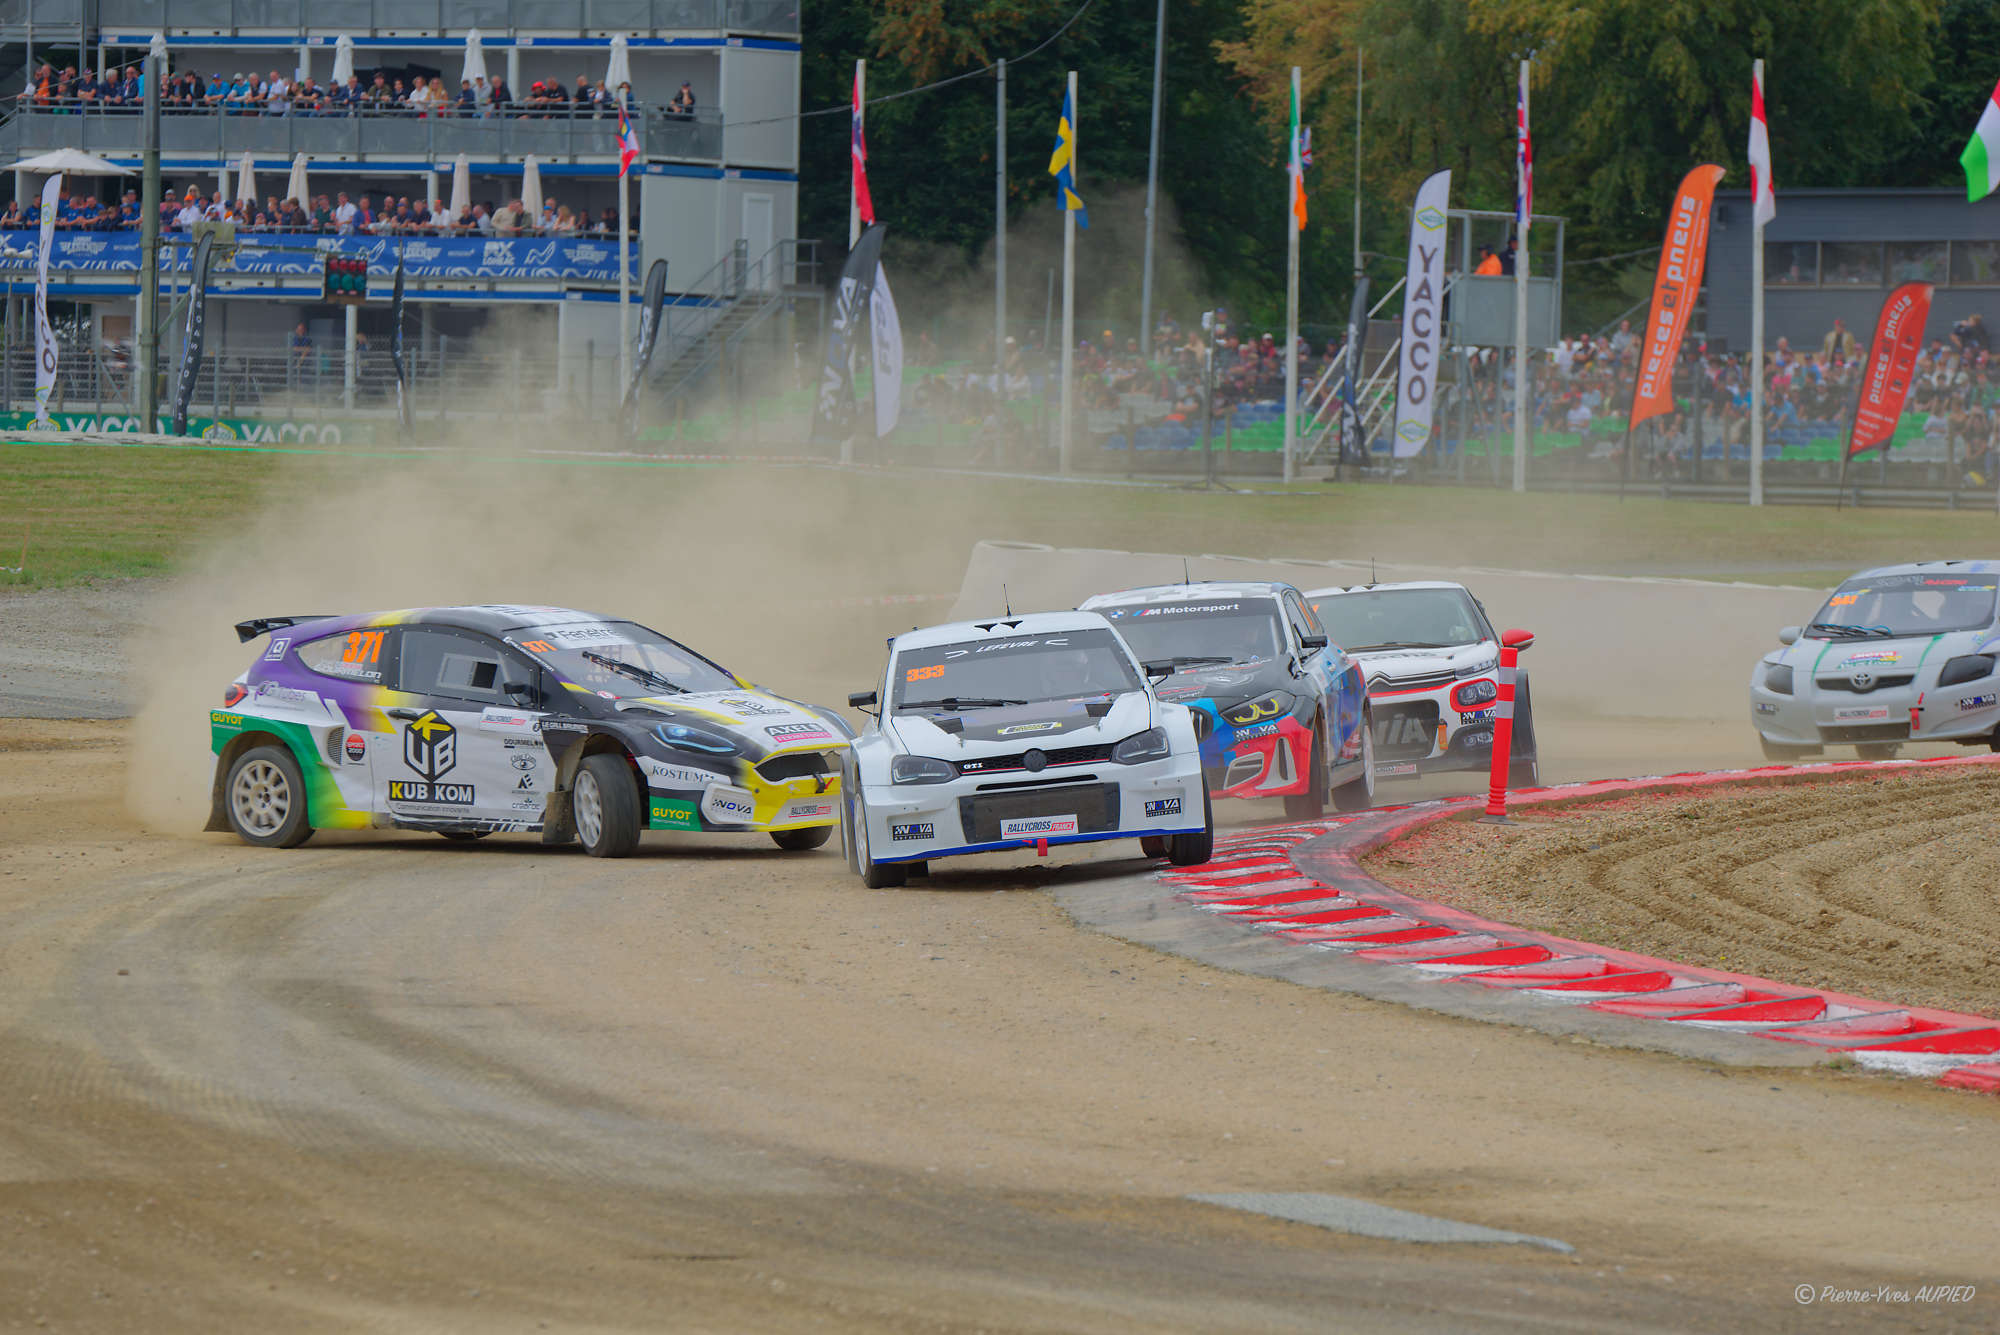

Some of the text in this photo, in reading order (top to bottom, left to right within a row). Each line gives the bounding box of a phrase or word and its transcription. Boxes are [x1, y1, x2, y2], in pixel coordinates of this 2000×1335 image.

[1407, 244, 1438, 406] YACCO
[1163, 603, 1240, 615] Motorsport
[342, 631, 385, 664] 371
[520, 639, 558, 653] 371
[906, 664, 945, 682] 333
[212, 712, 244, 725] GUYOT
[1235, 725, 1278, 738] NOVA
[391, 782, 473, 802] KUB KOM
[712, 799, 752, 814] NOVA
[1146, 800, 1180, 811] NOVA
[652, 807, 692, 821] GUYOT
[894, 824, 932, 835] NOVA
[1007, 821, 1075, 833] RALLYCROSS FRANCE
